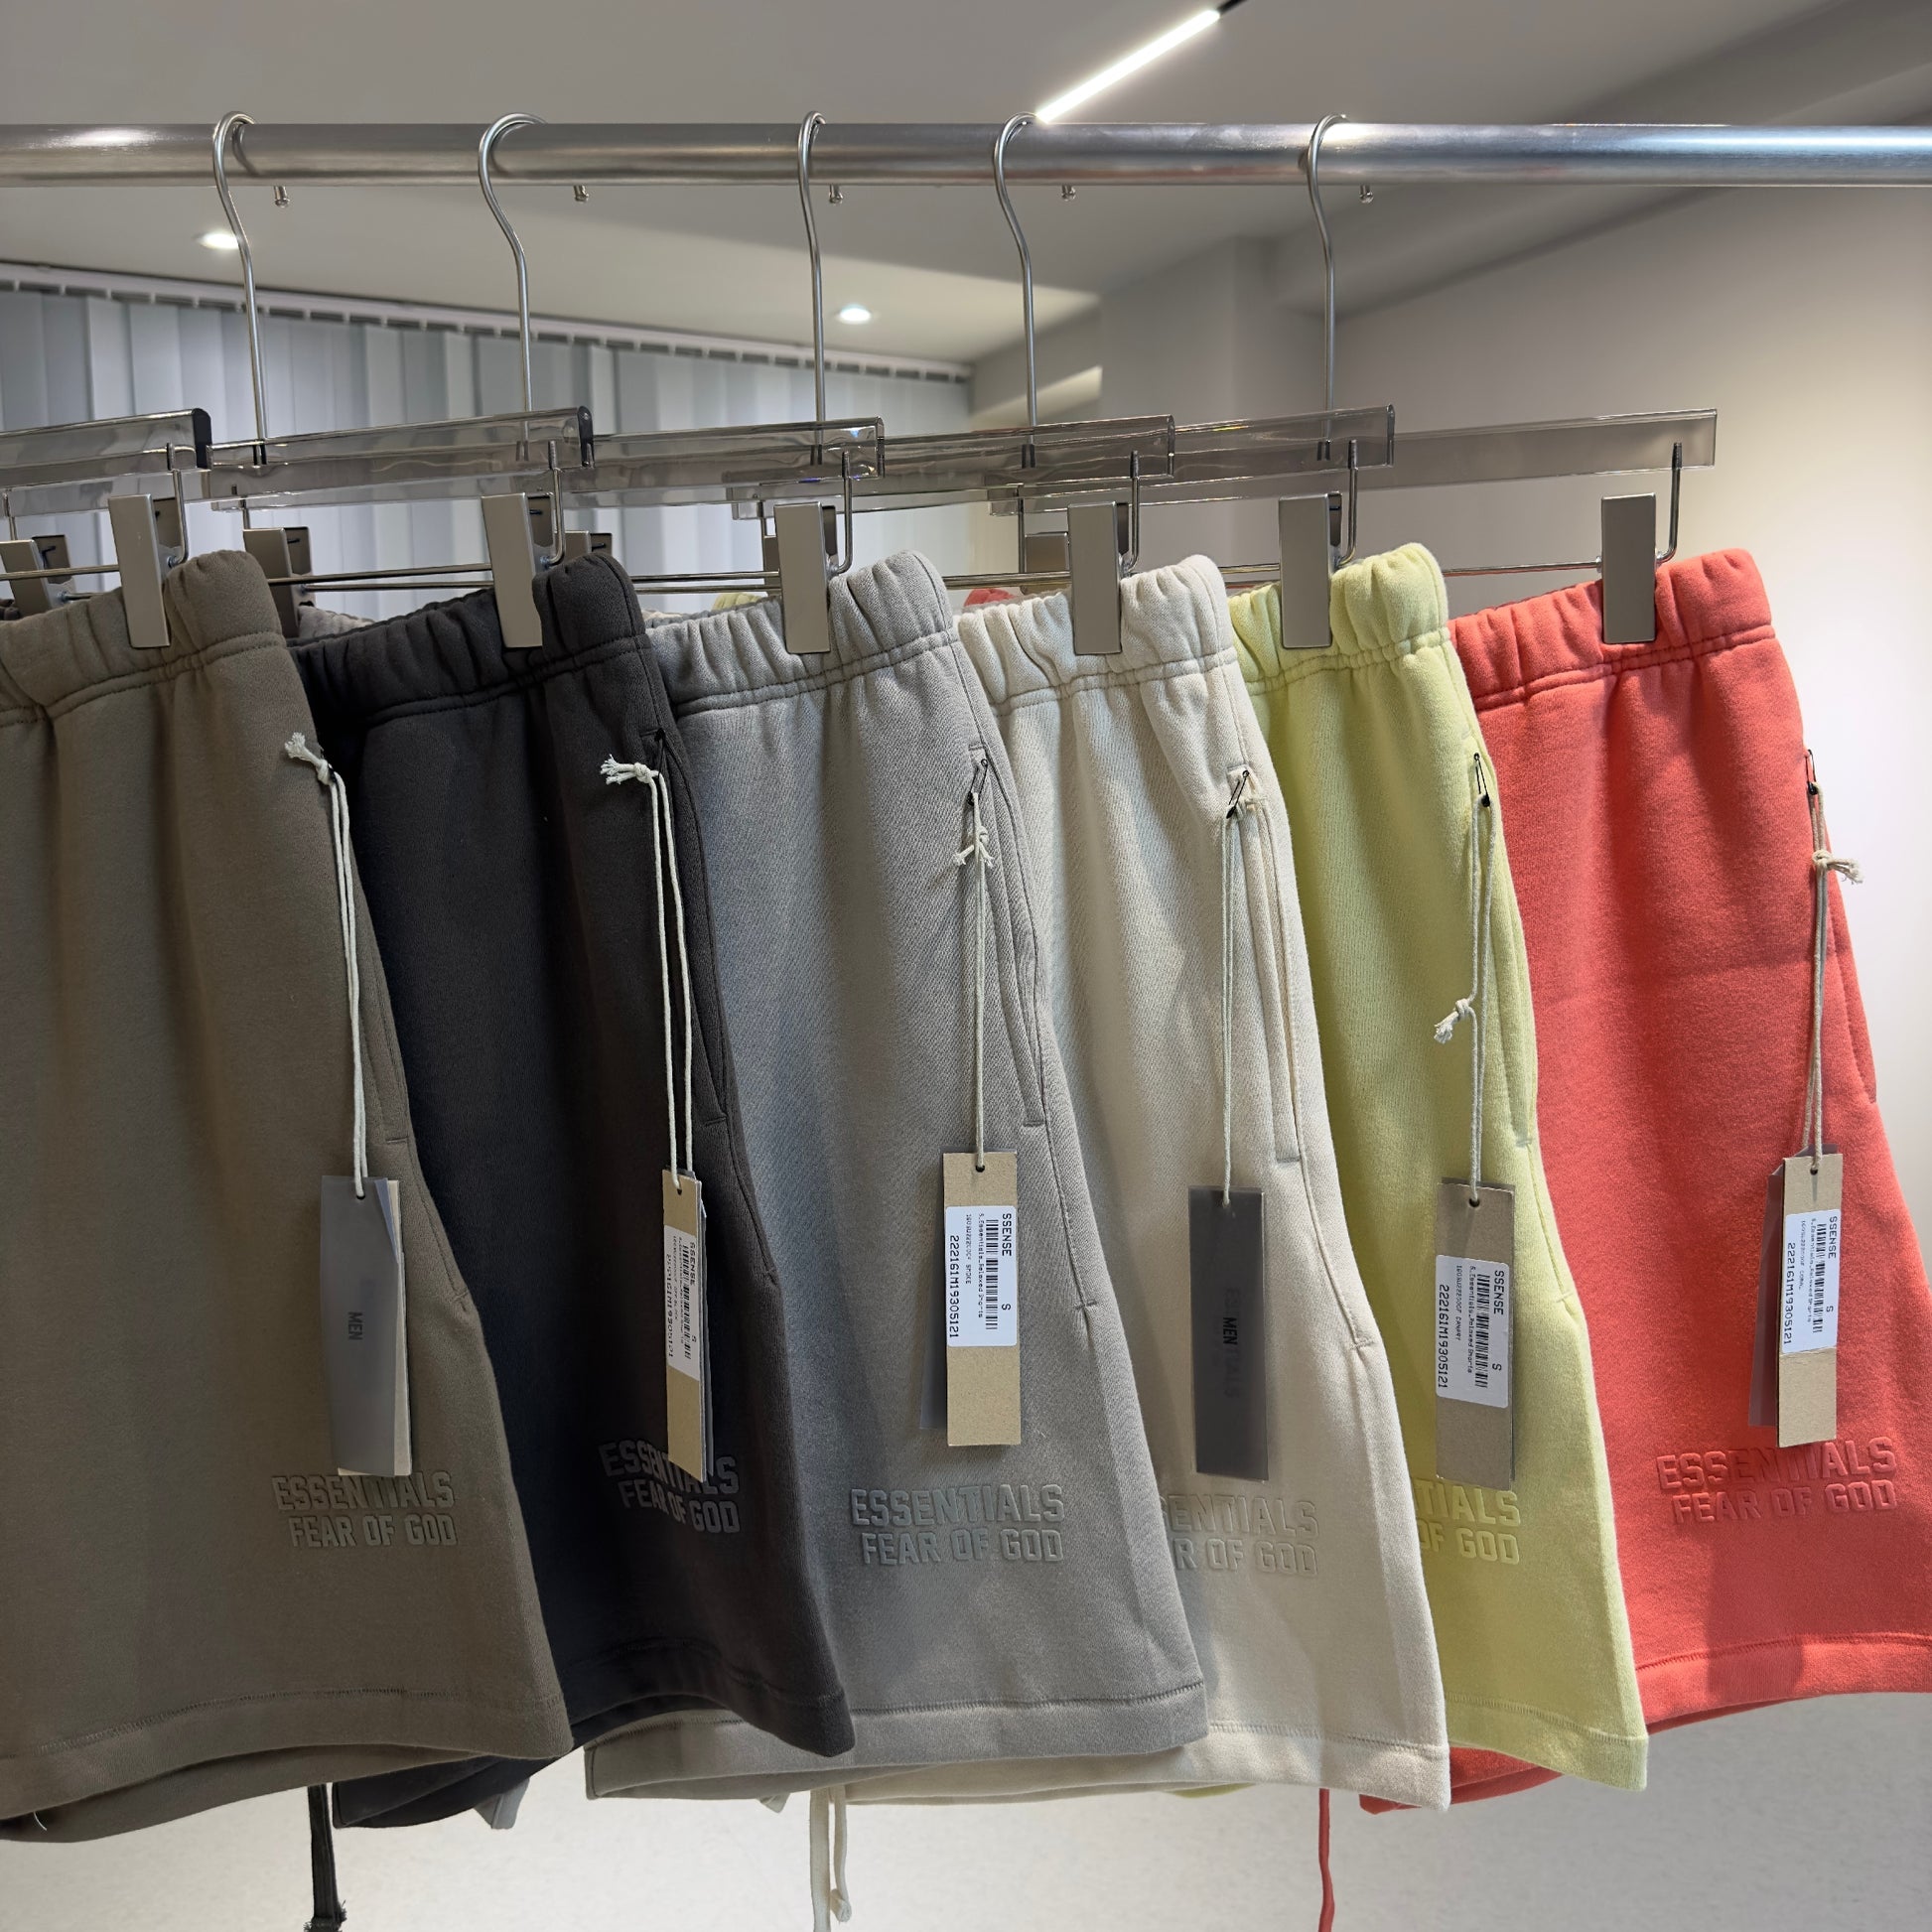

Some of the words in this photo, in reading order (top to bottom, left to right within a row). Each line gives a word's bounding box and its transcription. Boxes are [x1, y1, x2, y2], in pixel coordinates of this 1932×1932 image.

[1003, 1213, 1012, 1256] SSENSE
[950, 1235, 959, 1337] 222161M19305121
[1494, 1271, 1504, 1314] SSENSE
[1784, 1243, 1795, 1344] 222161M19305121
[348, 1311, 363, 1340] MEN
[1223, 1317, 1237, 1345] MEN
[1439, 1285, 1449, 1388] 222161M19305121
[1656, 1437, 1897, 1490] ESSENTIALS
[271, 1471, 455, 1511] ESSENTIALS
[618, 1478, 670, 1515] FEAR
[667, 1491, 686, 1525] OF
[689, 1500, 741, 1533] GOD
[850, 1483, 1065, 1526] ESSENTIALS
[1411, 1477, 1521, 1527] TIALS
[1672, 1491, 1761, 1524] FEAR
[1770, 1486, 1812, 1517] OF
[1824, 1478, 1897, 1513] GOD
[289, 1515, 356, 1548] FEAR
[362, 1514, 395, 1547] OF
[404, 1513, 459, 1546] GOD
[1160, 1493, 1319, 1537] ENTIALS
[861, 1531, 941, 1565] FEAR
[950, 1528, 989, 1562] OF
[1000, 1528, 1064, 1562] GOD
[1205, 1538, 1244, 1572] OF
[1254, 1540, 1318, 1577] GOD
[1454, 1527, 1520, 1566] GOD
